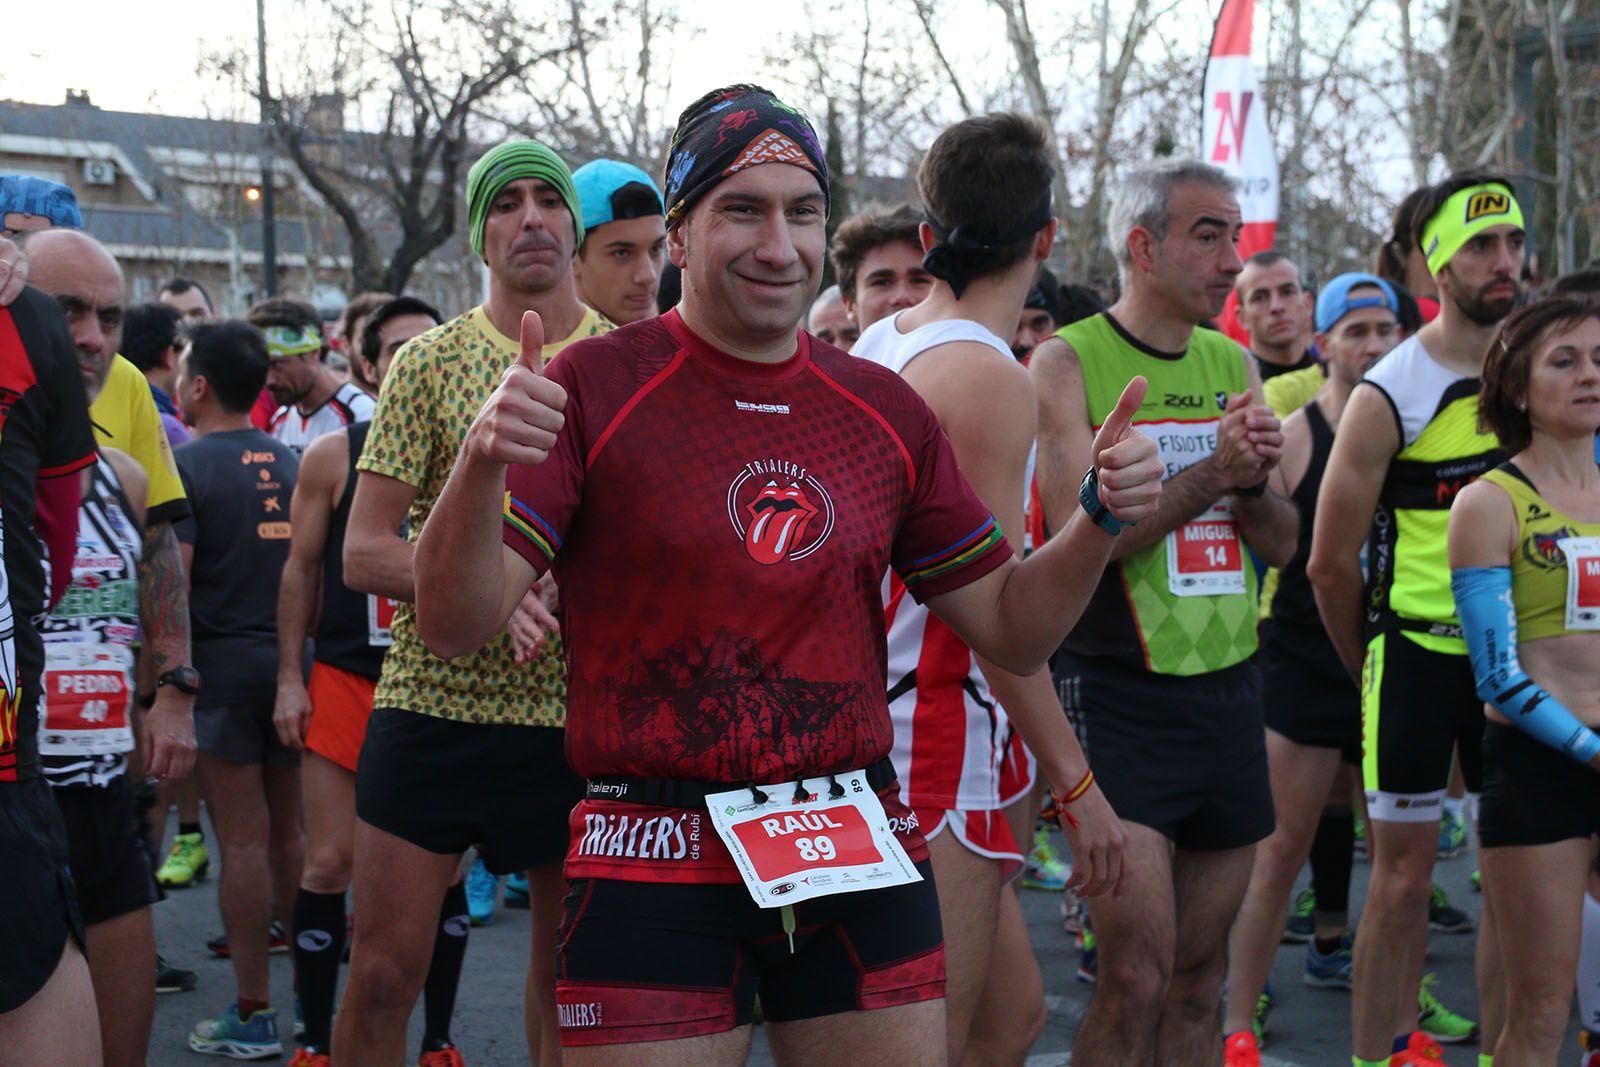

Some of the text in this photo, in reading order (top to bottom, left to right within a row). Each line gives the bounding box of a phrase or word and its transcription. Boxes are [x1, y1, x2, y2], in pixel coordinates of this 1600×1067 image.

[1474, 195, 1504, 213] IN
[1164, 393, 1204, 409] 2XU
[1184, 525, 1235, 542] MIGUEL
[1204, 545, 1227, 567] 14
[760, 808, 843, 839] RAÚL
[689, 844, 700, 860] de
[794, 836, 837, 862] 89
